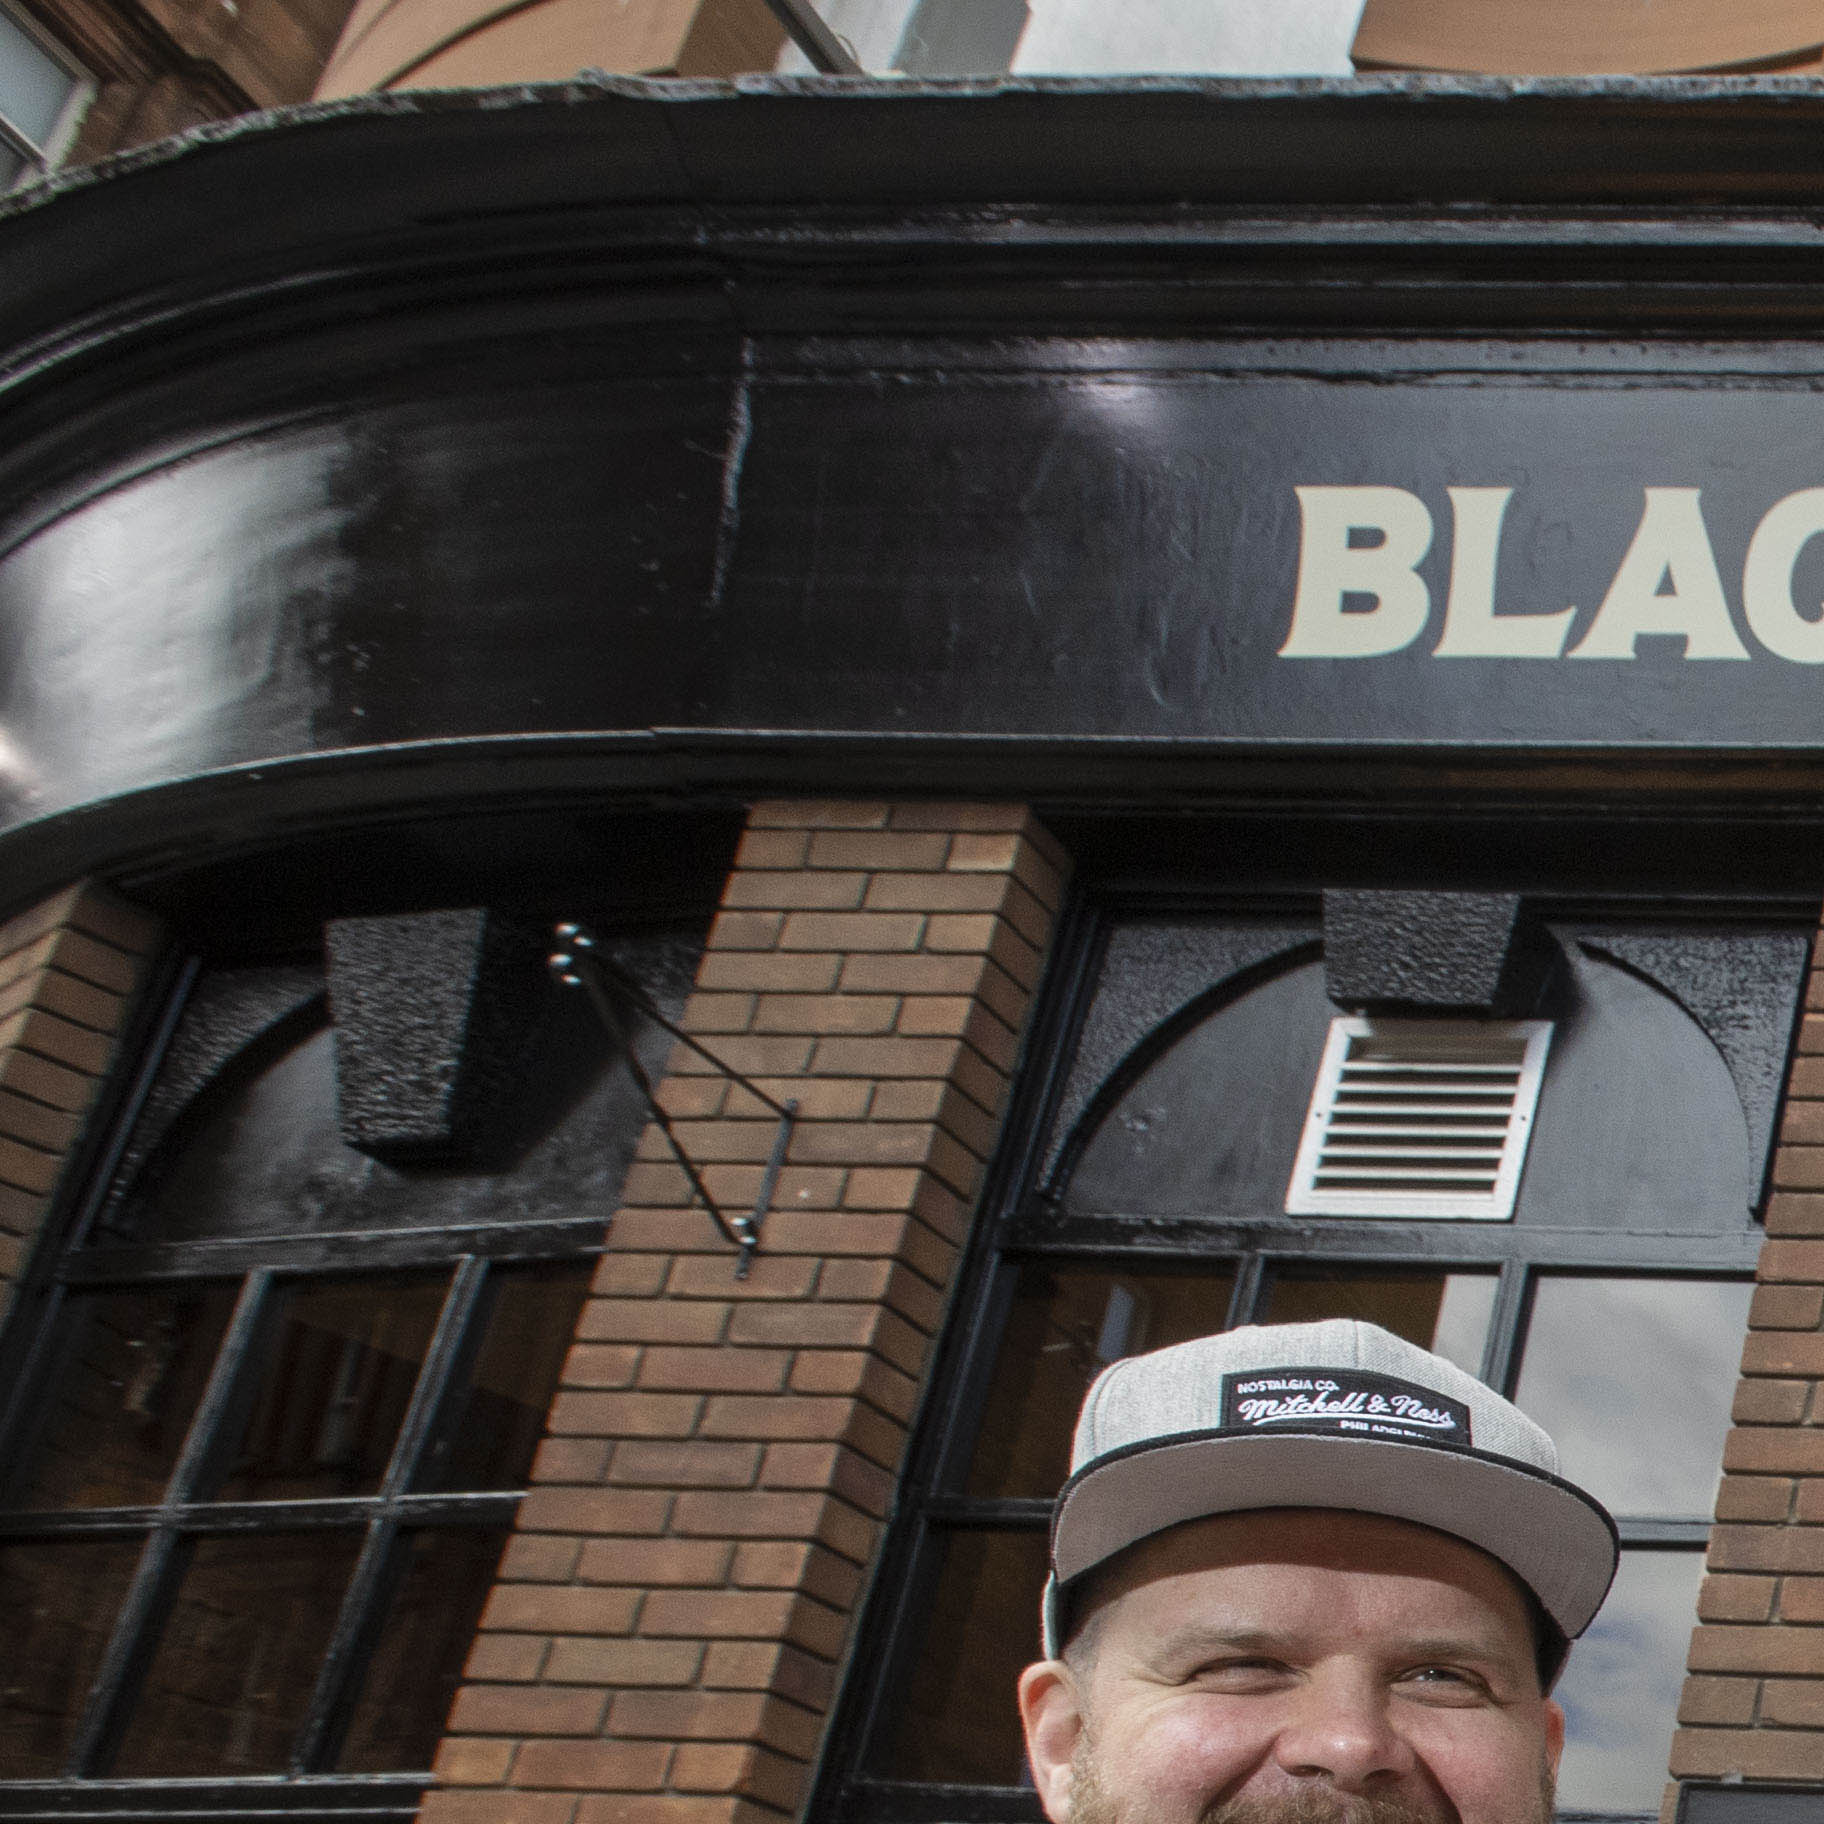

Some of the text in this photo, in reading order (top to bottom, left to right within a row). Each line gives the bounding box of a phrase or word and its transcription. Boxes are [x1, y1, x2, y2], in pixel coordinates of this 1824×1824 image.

[1237, 1379, 1340, 1394] NOSTALGIA CO.
[1238, 1391, 1456, 1424] Mitchell & Ness
